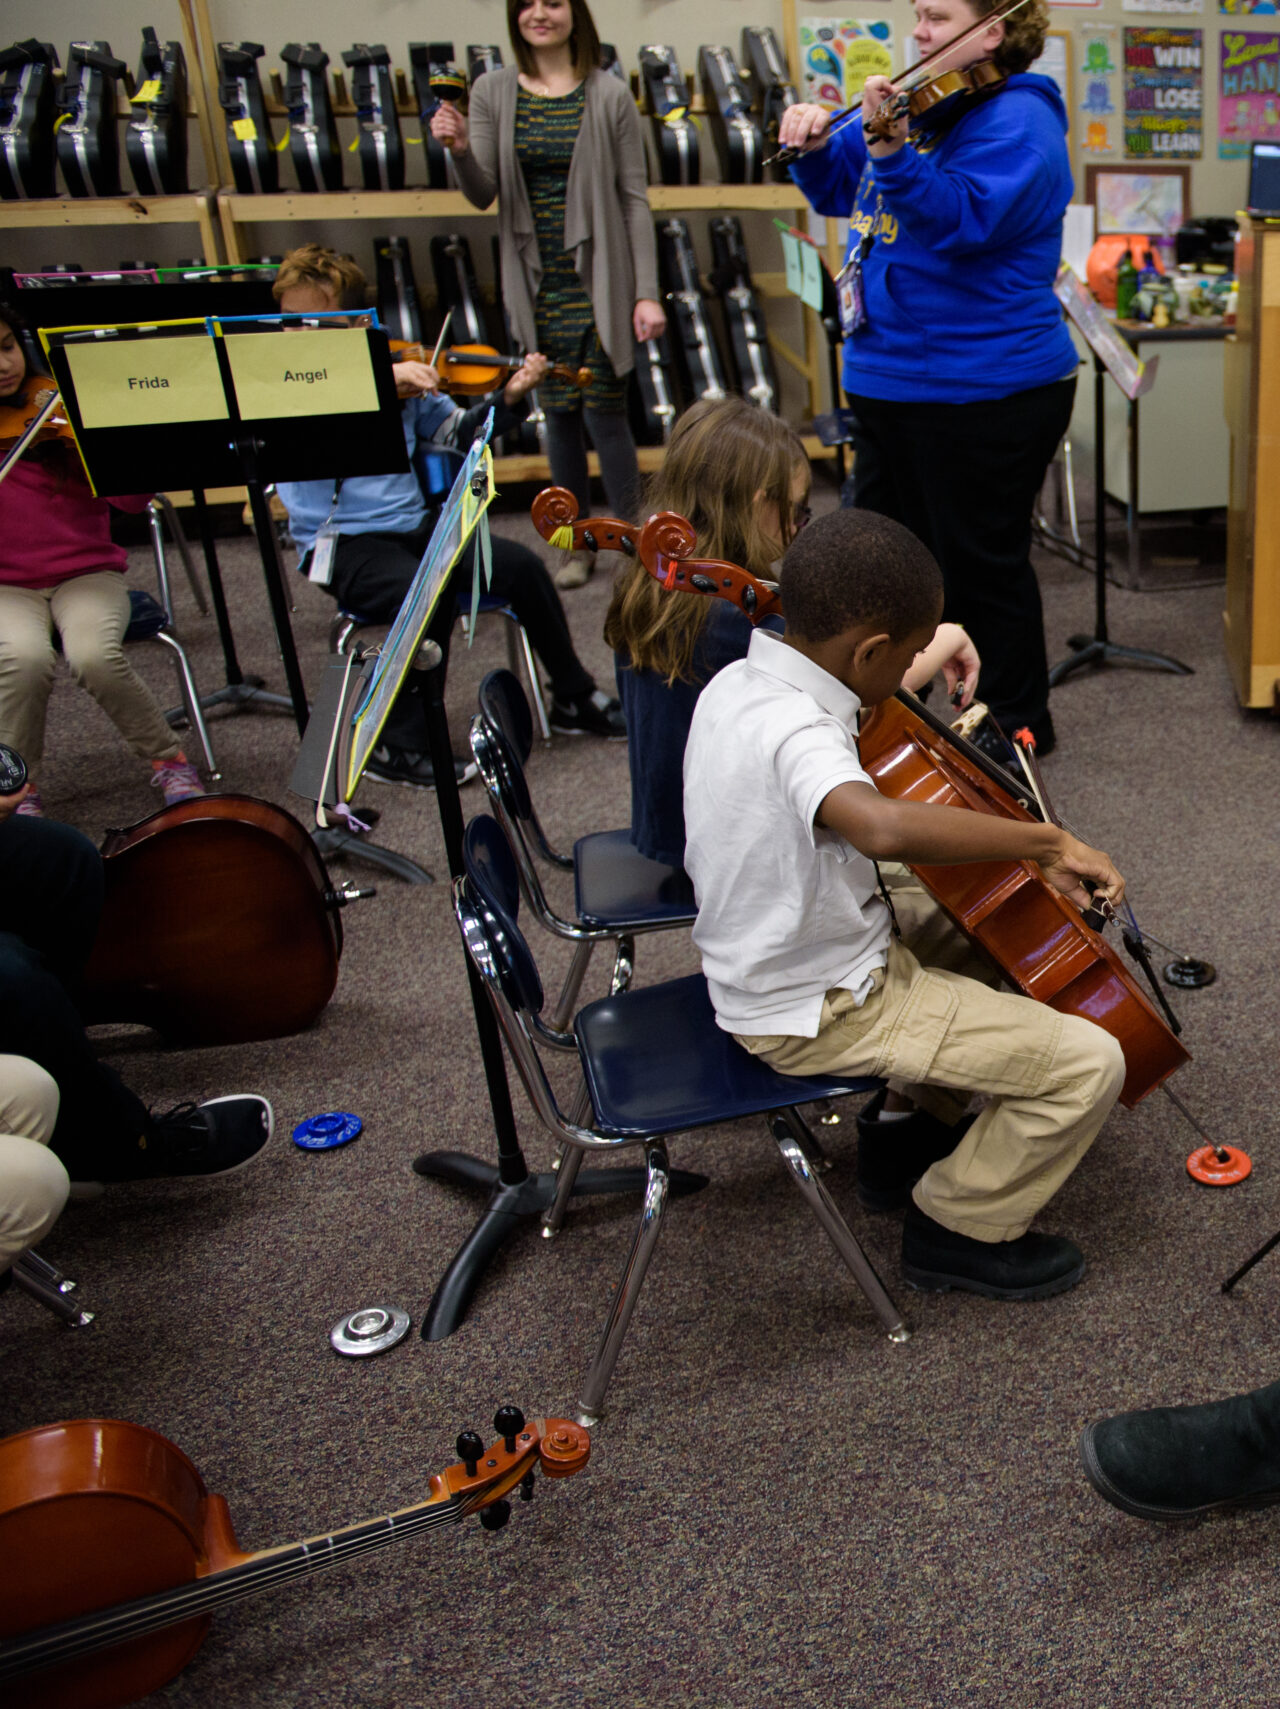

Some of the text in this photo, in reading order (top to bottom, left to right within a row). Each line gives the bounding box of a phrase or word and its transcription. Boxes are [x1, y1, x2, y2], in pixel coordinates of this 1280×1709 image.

[1153, 46, 1201, 68] WIN
[1154, 88, 1201, 110] LOSE
[1152, 132, 1201, 152] LEARN
[128, 376, 170, 390] Frida
[283, 368, 328, 384] Angel
